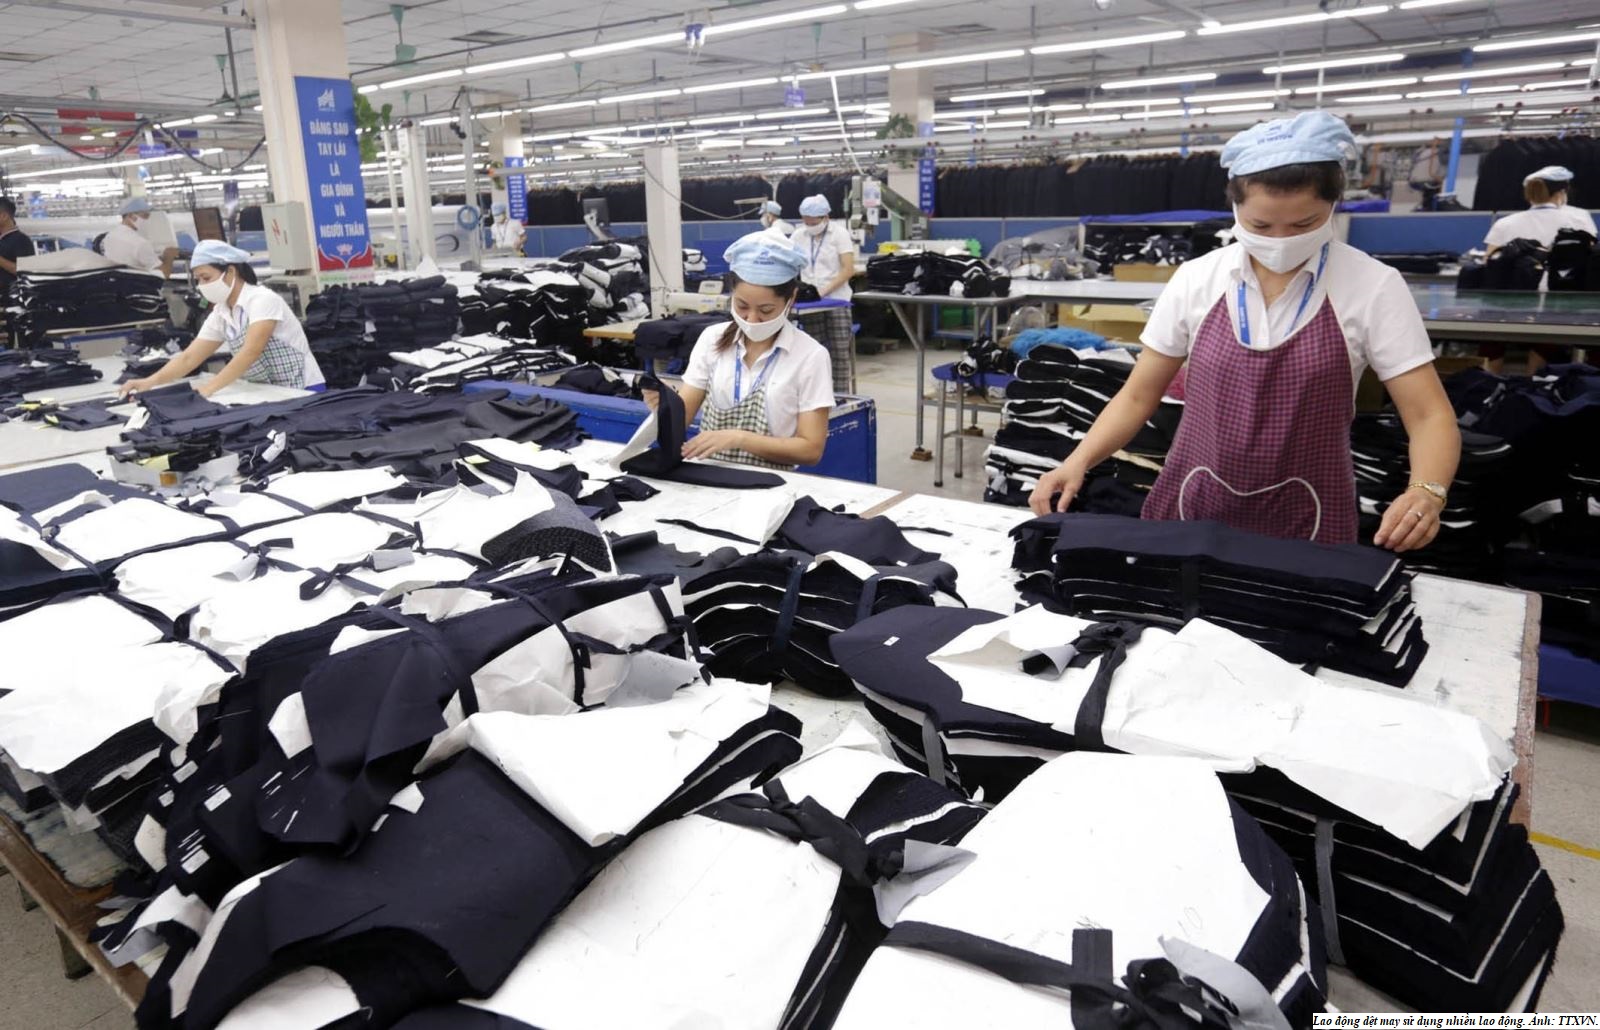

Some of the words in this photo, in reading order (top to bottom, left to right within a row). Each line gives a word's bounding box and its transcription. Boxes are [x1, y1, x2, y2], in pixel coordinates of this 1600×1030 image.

[332, 121, 349, 136] SAU
[317, 142, 332, 156] TAY
[329, 161, 340, 176] LÀ
[320, 183, 335, 197] GIA
[334, 202, 346, 217] VÀ
[344, 221, 365, 237] THÂN
